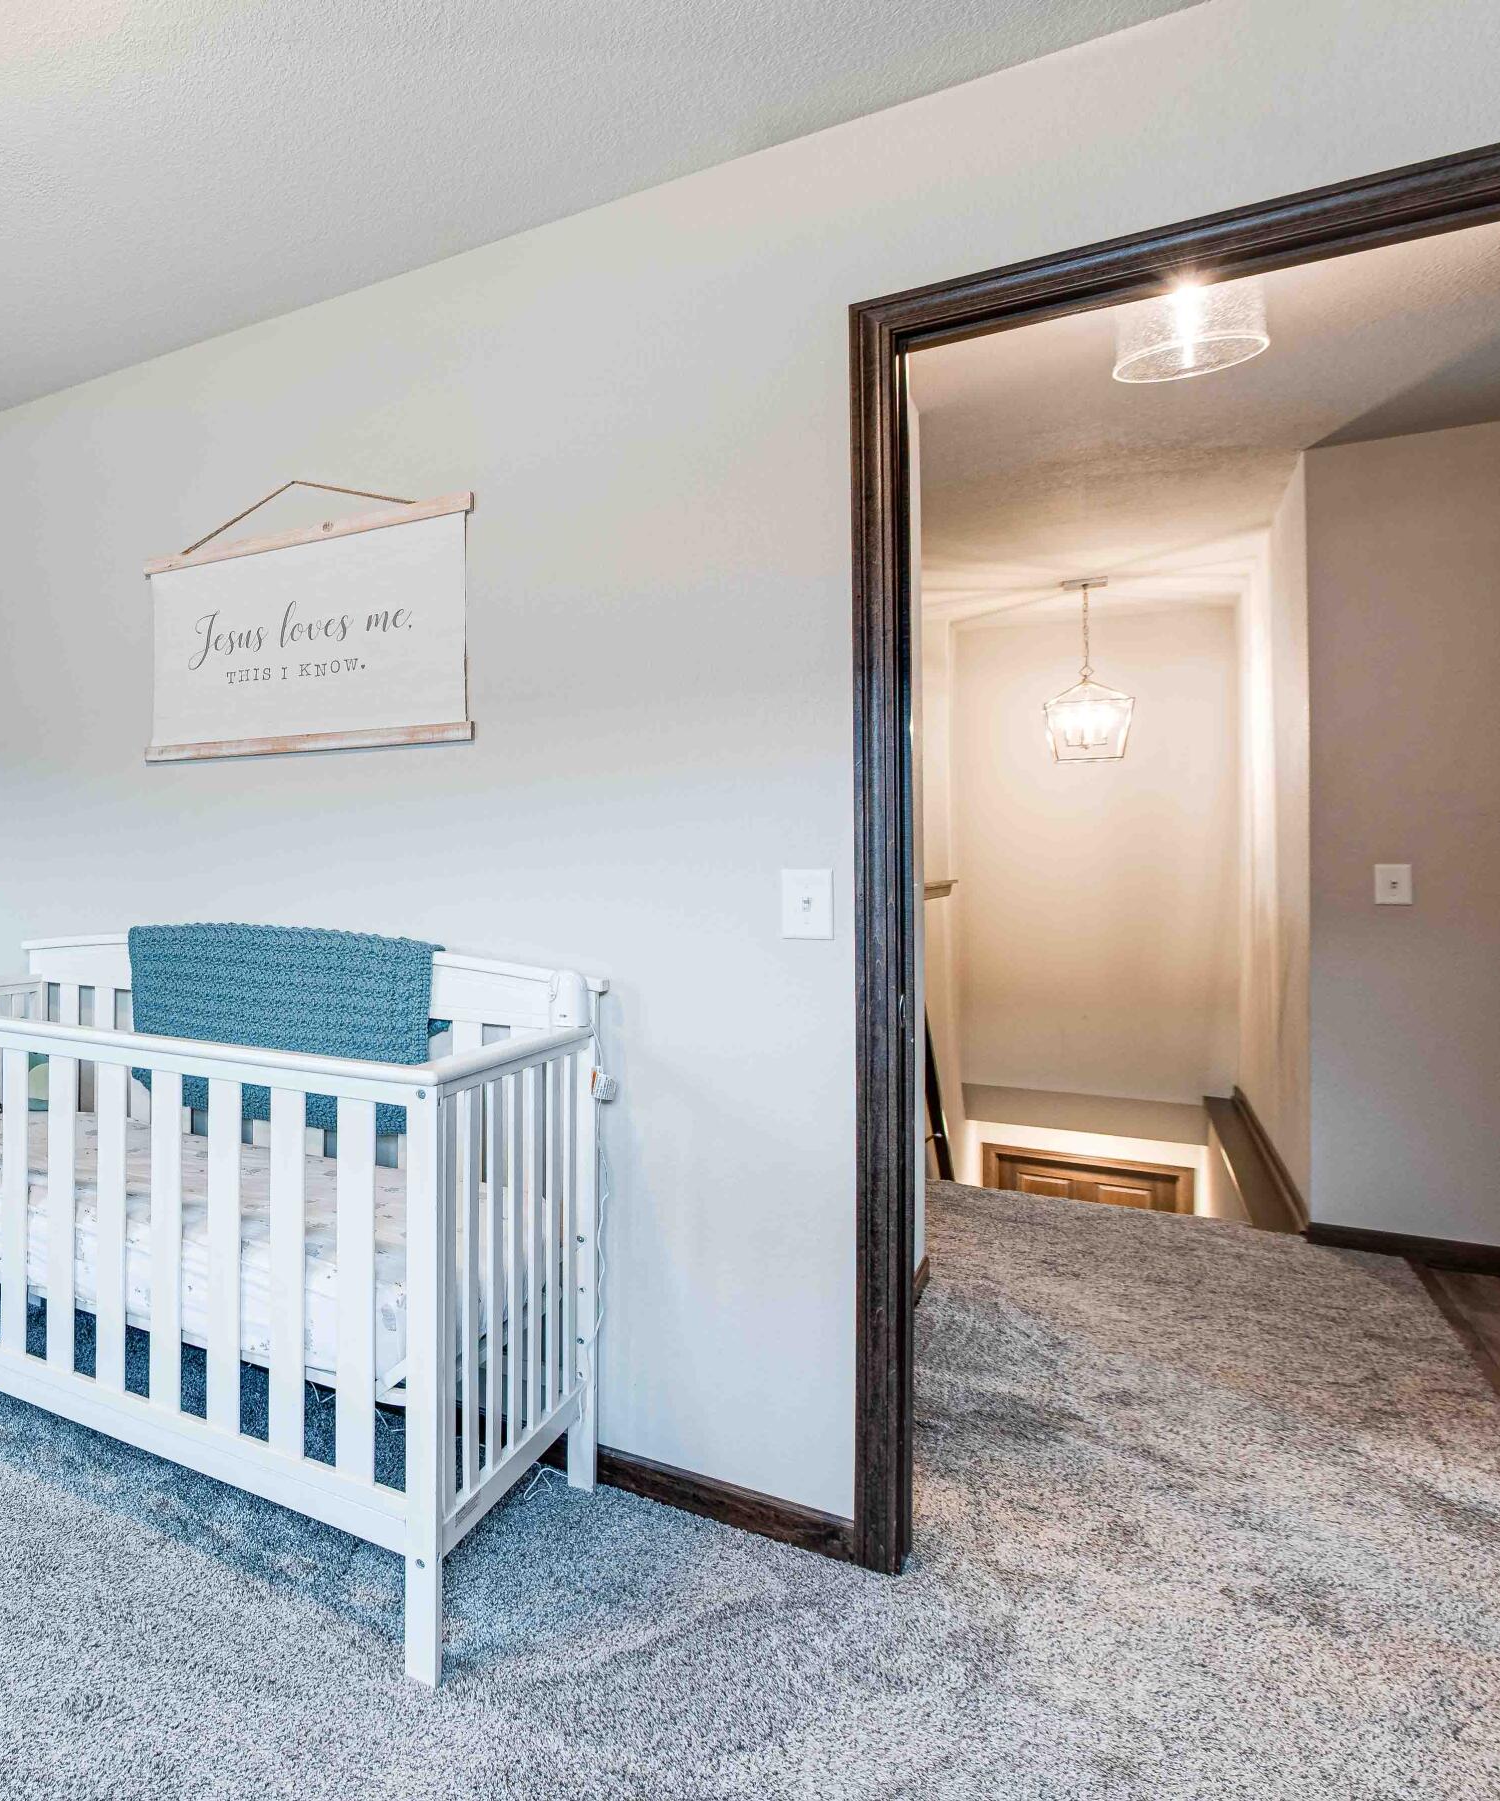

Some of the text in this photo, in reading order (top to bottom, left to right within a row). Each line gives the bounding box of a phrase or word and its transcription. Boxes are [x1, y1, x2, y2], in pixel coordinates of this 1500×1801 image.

[188, 609, 267, 670] Jesus
[280, 600, 353, 648] loves
[226, 667, 272, 684] THIS
[281, 667, 287, 680] I
